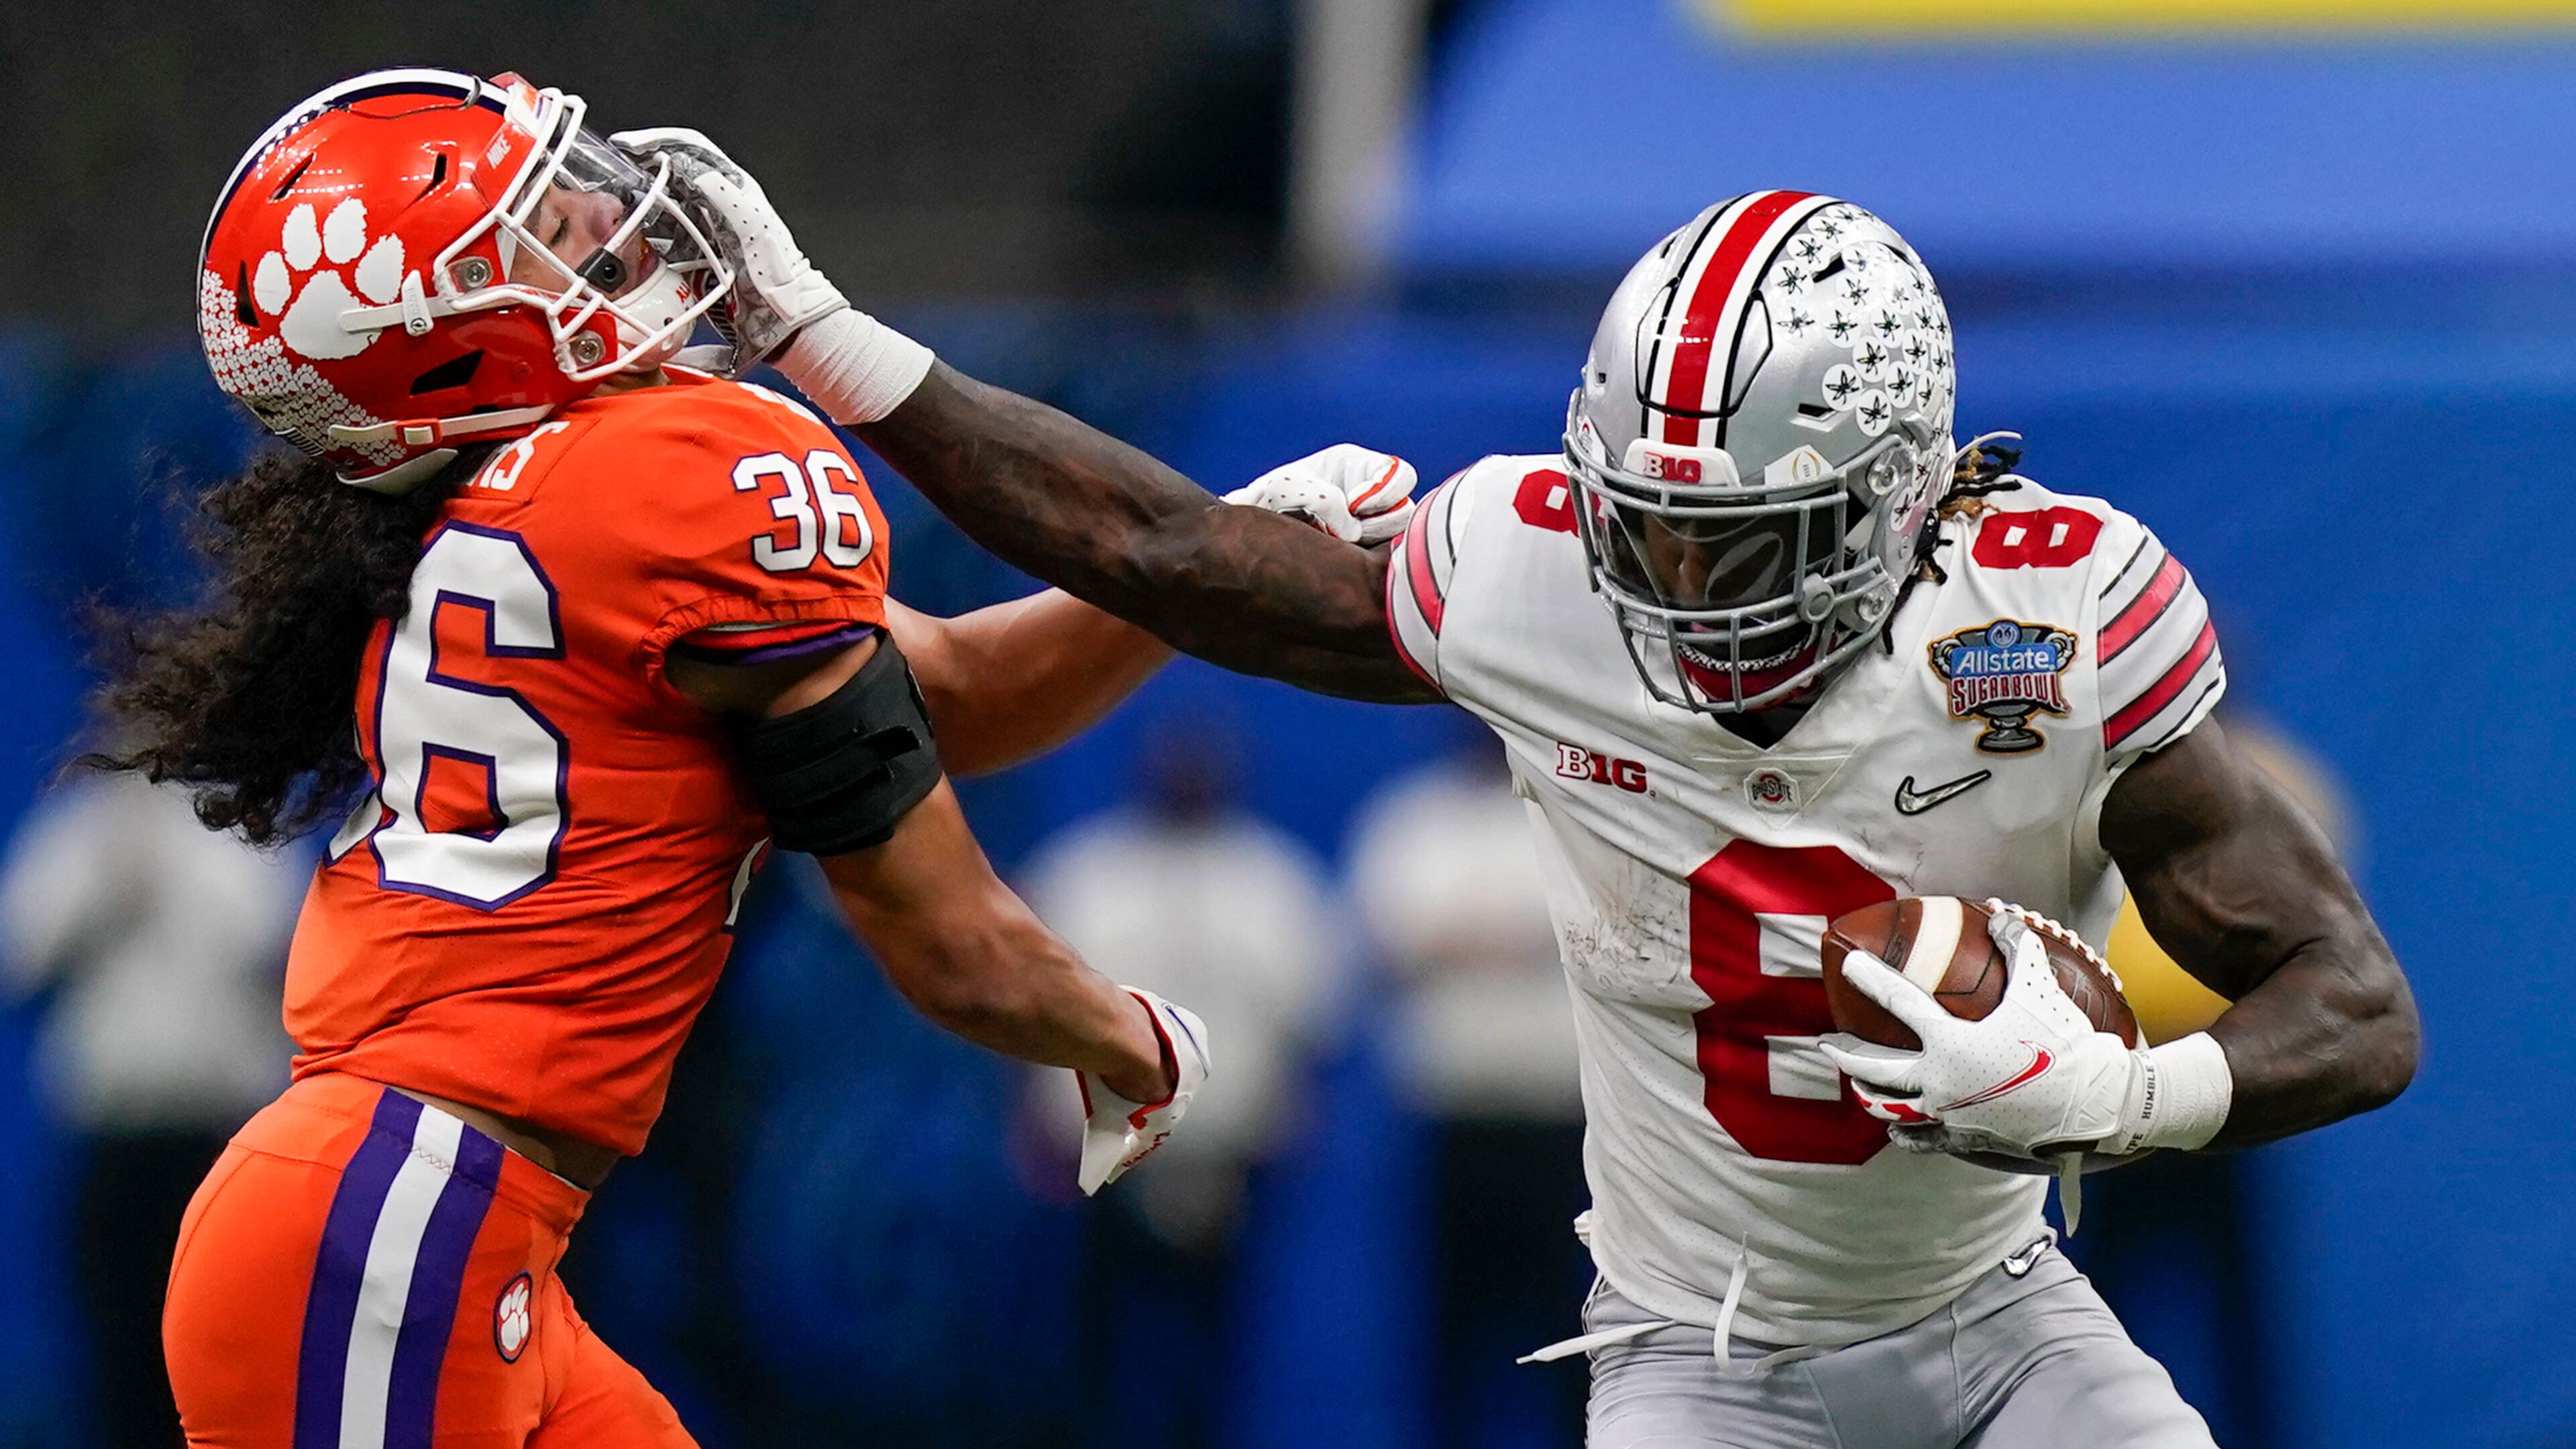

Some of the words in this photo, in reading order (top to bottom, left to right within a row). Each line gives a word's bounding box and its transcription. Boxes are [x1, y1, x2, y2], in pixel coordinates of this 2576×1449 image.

[486, 133, 512, 169] NIKE
[731, 449, 874, 572] 36
[1972, 506, 2104, 569] 8
[1956, 647, 2051, 674] Allstate
[323, 519, 570, 911] 6
[1685, 838, 1897, 1165] 8
[2141, 1065, 2156, 1120] HUMBLE
